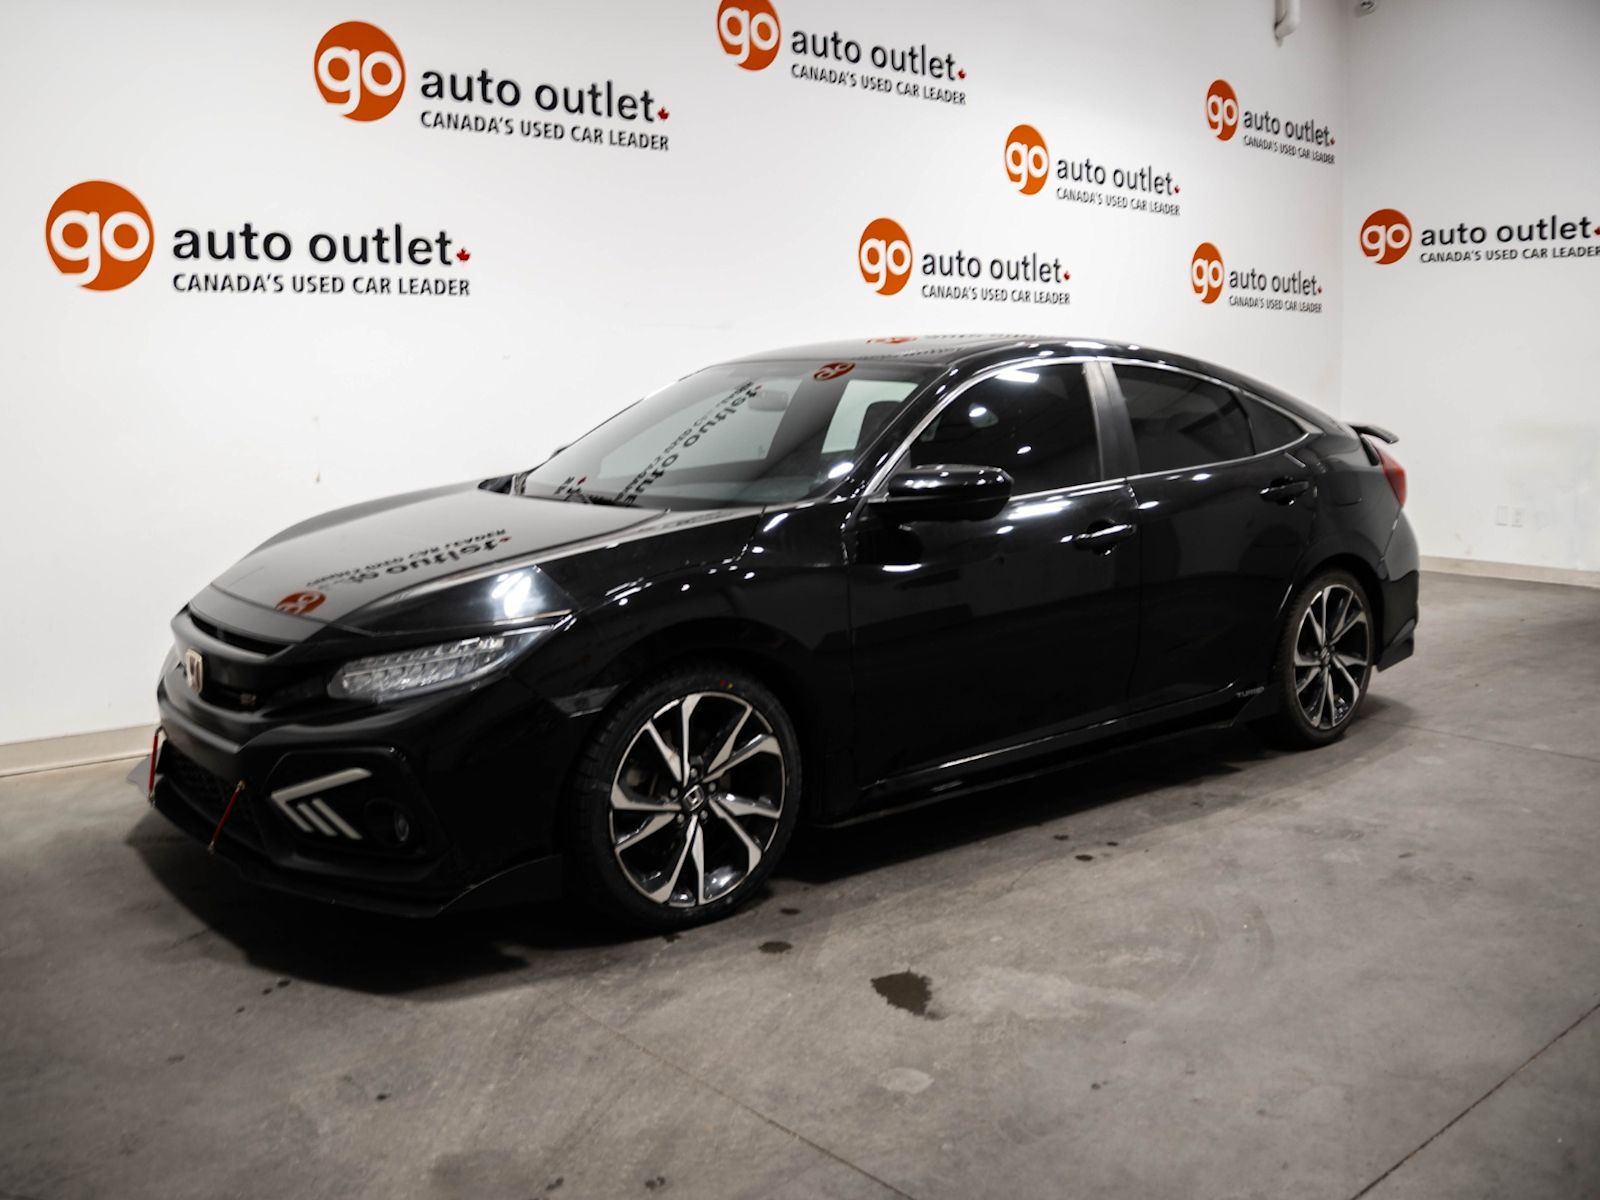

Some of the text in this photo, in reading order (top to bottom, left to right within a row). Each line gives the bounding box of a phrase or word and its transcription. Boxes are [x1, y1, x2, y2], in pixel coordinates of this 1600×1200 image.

[719, 6, 955, 81] go auto outlet
[318, 46, 654, 122] go auto outlet
[791, 63, 965, 105] CANADA'S USED CAR LEADER
[421, 111, 669, 151] CANADA'S USED CAR LEADER
[1207, 94, 1330, 147] go auto outlet
[1005, 141, 1172, 196] go auto outlet
[1279, 143, 1297, 156] USED
[1297, 147, 1311, 159] CAR
[1311, 150, 1335, 165] LEADER
[1056, 187, 1180, 216] CANADA'S USED CAR LEADER
[50, 210, 452, 282] go auto outlet
[1362, 215, 1591, 260] go auto outlet
[1419, 250, 1481, 263] CANADA'S
[1485, 249, 1518, 261] USED
[1522, 248, 1548, 259] CAR
[173, 274, 470, 296] CANADA'S USED CAR LEADER
[861, 238, 1061, 290] go auto outlet
[1191, 256, 1317, 299] go auto outlet
[921, 284, 1070, 305] CANADA'S USED CAR LEADER
[1266, 299, 1284, 310] USED
[1284, 300, 1299, 311] CAR
[1299, 302, 1322, 314] LEADER
